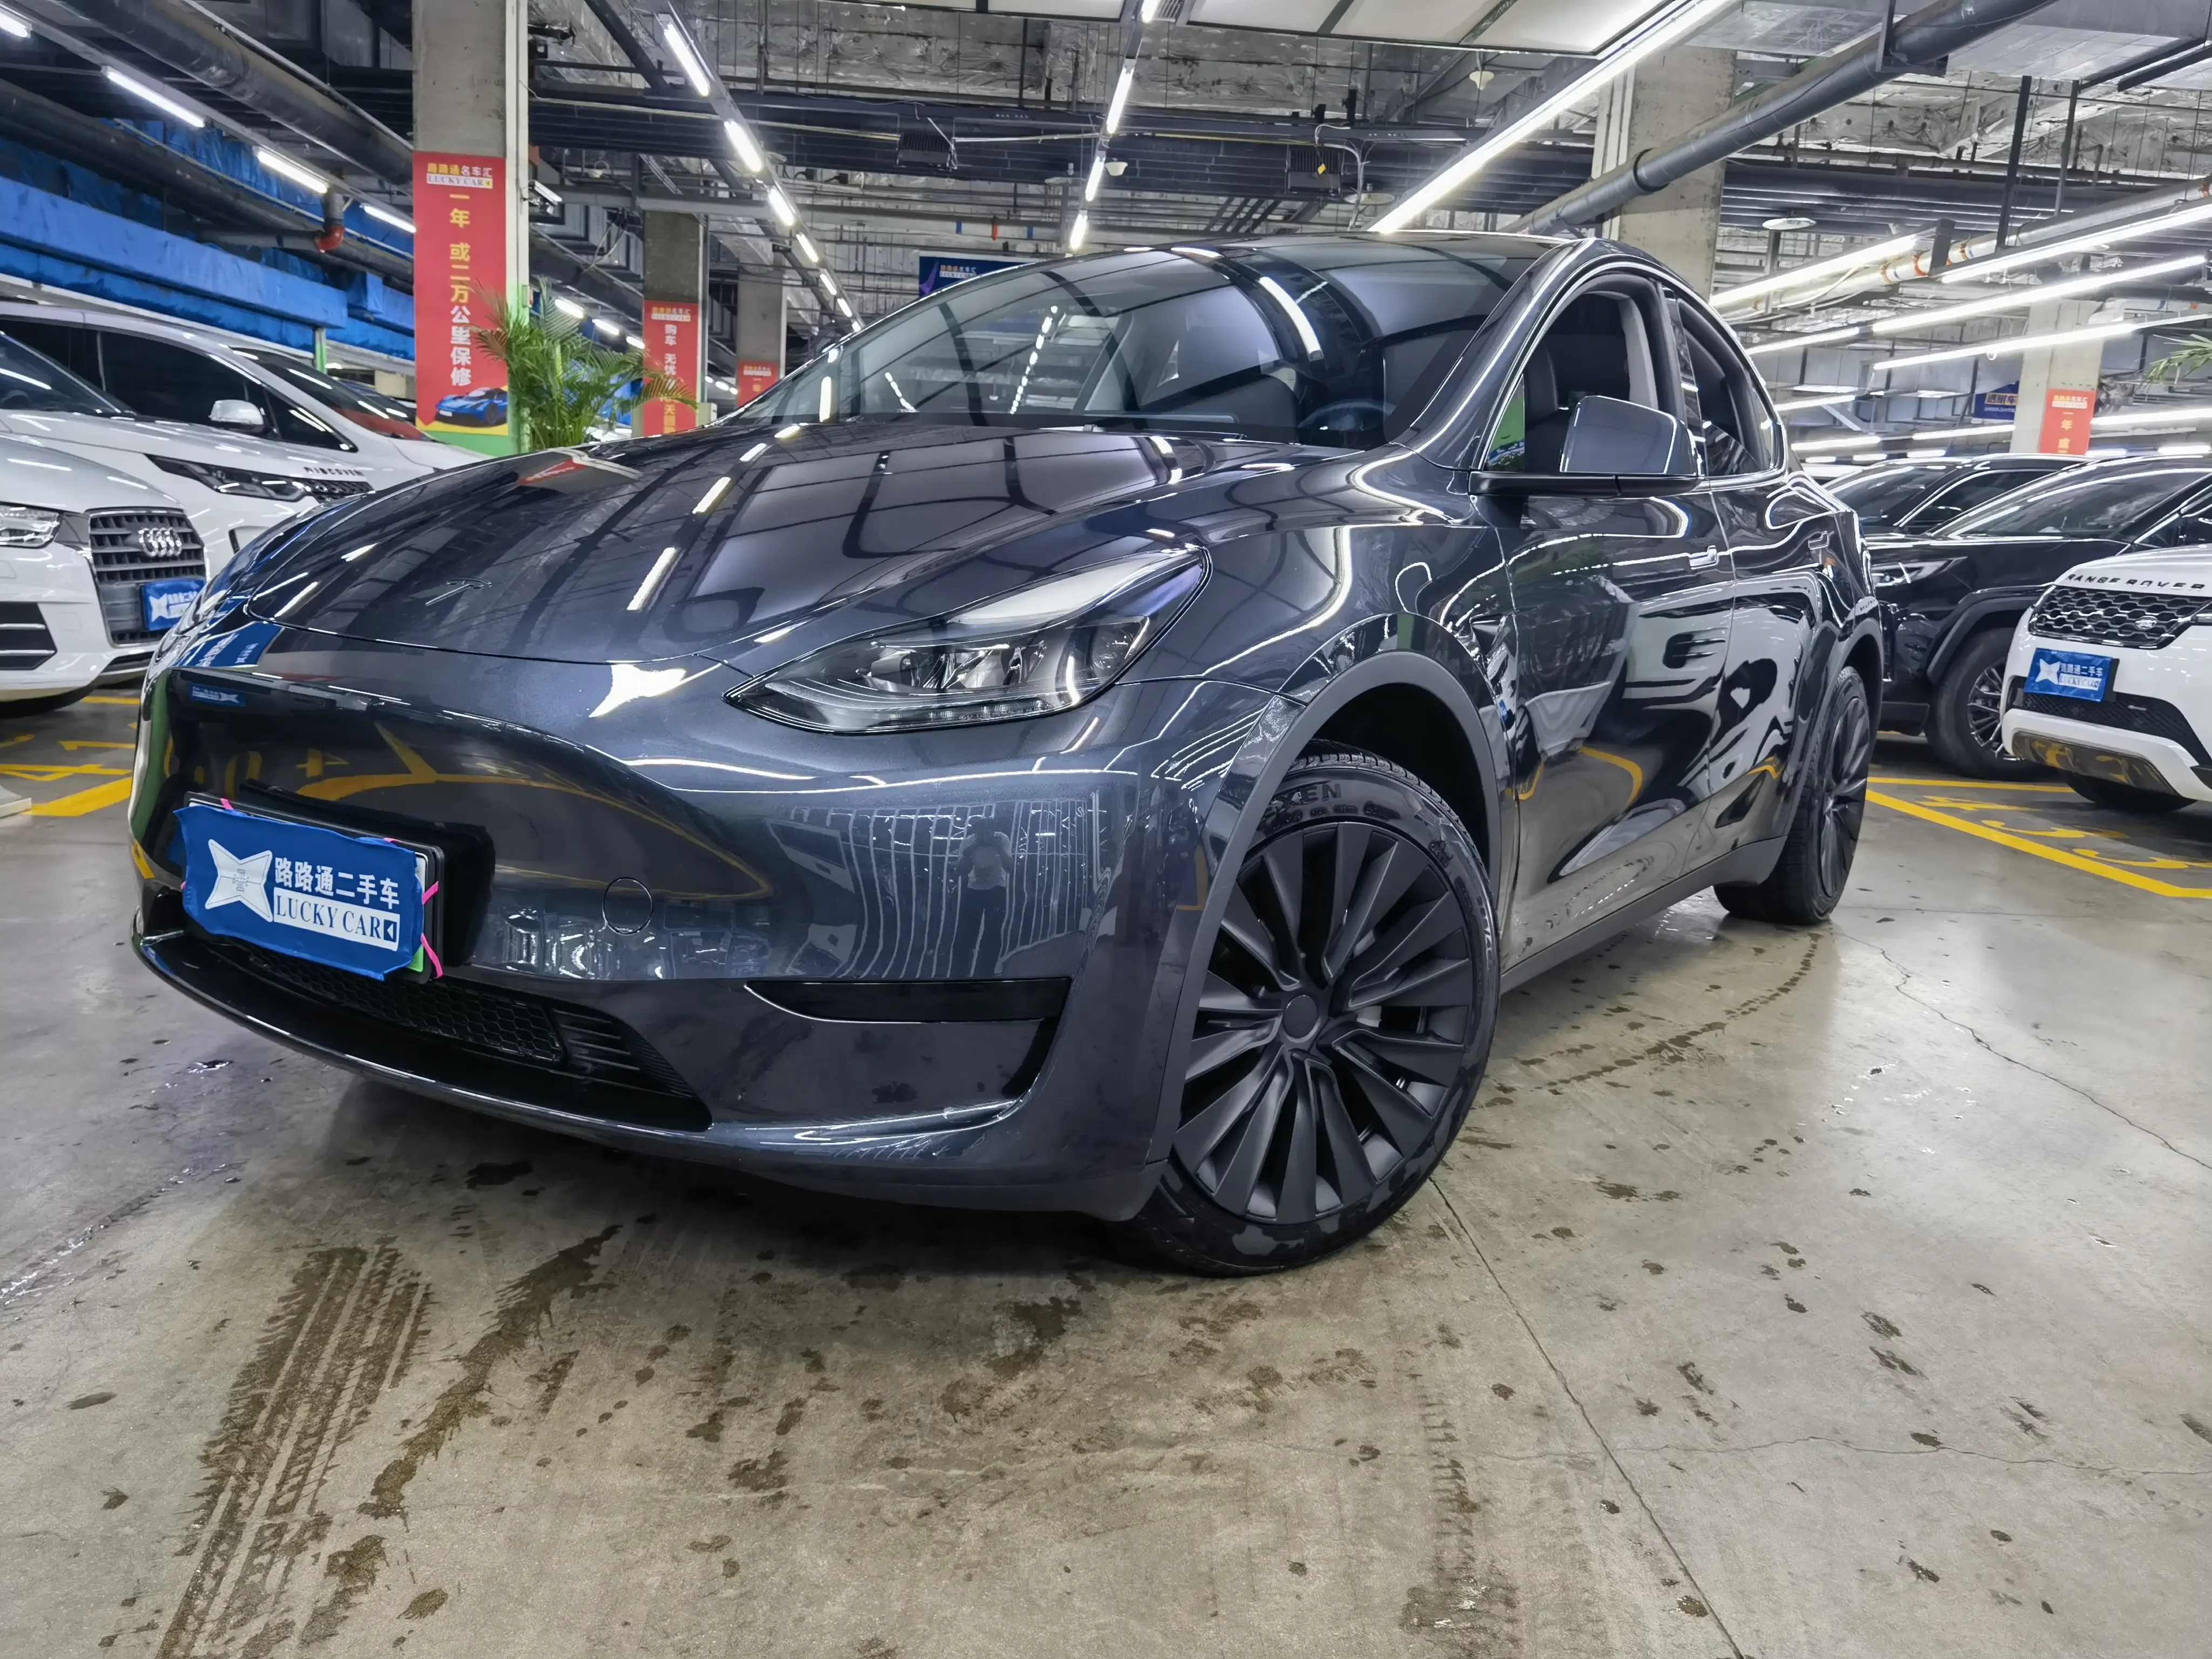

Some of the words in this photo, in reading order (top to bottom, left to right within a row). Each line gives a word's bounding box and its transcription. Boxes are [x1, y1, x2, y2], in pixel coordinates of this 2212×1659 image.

[428, 174, 460, 184] LUCKY
[463, 178, 483, 186] CAR
[2067, 574, 2121, 584] RANGE
[2125, 578, 2206, 591] ROVER
[274, 857, 400, 909] 路路通二手车
[276, 895, 338, 928] LUCKY
[343, 911, 382, 939] CAR
